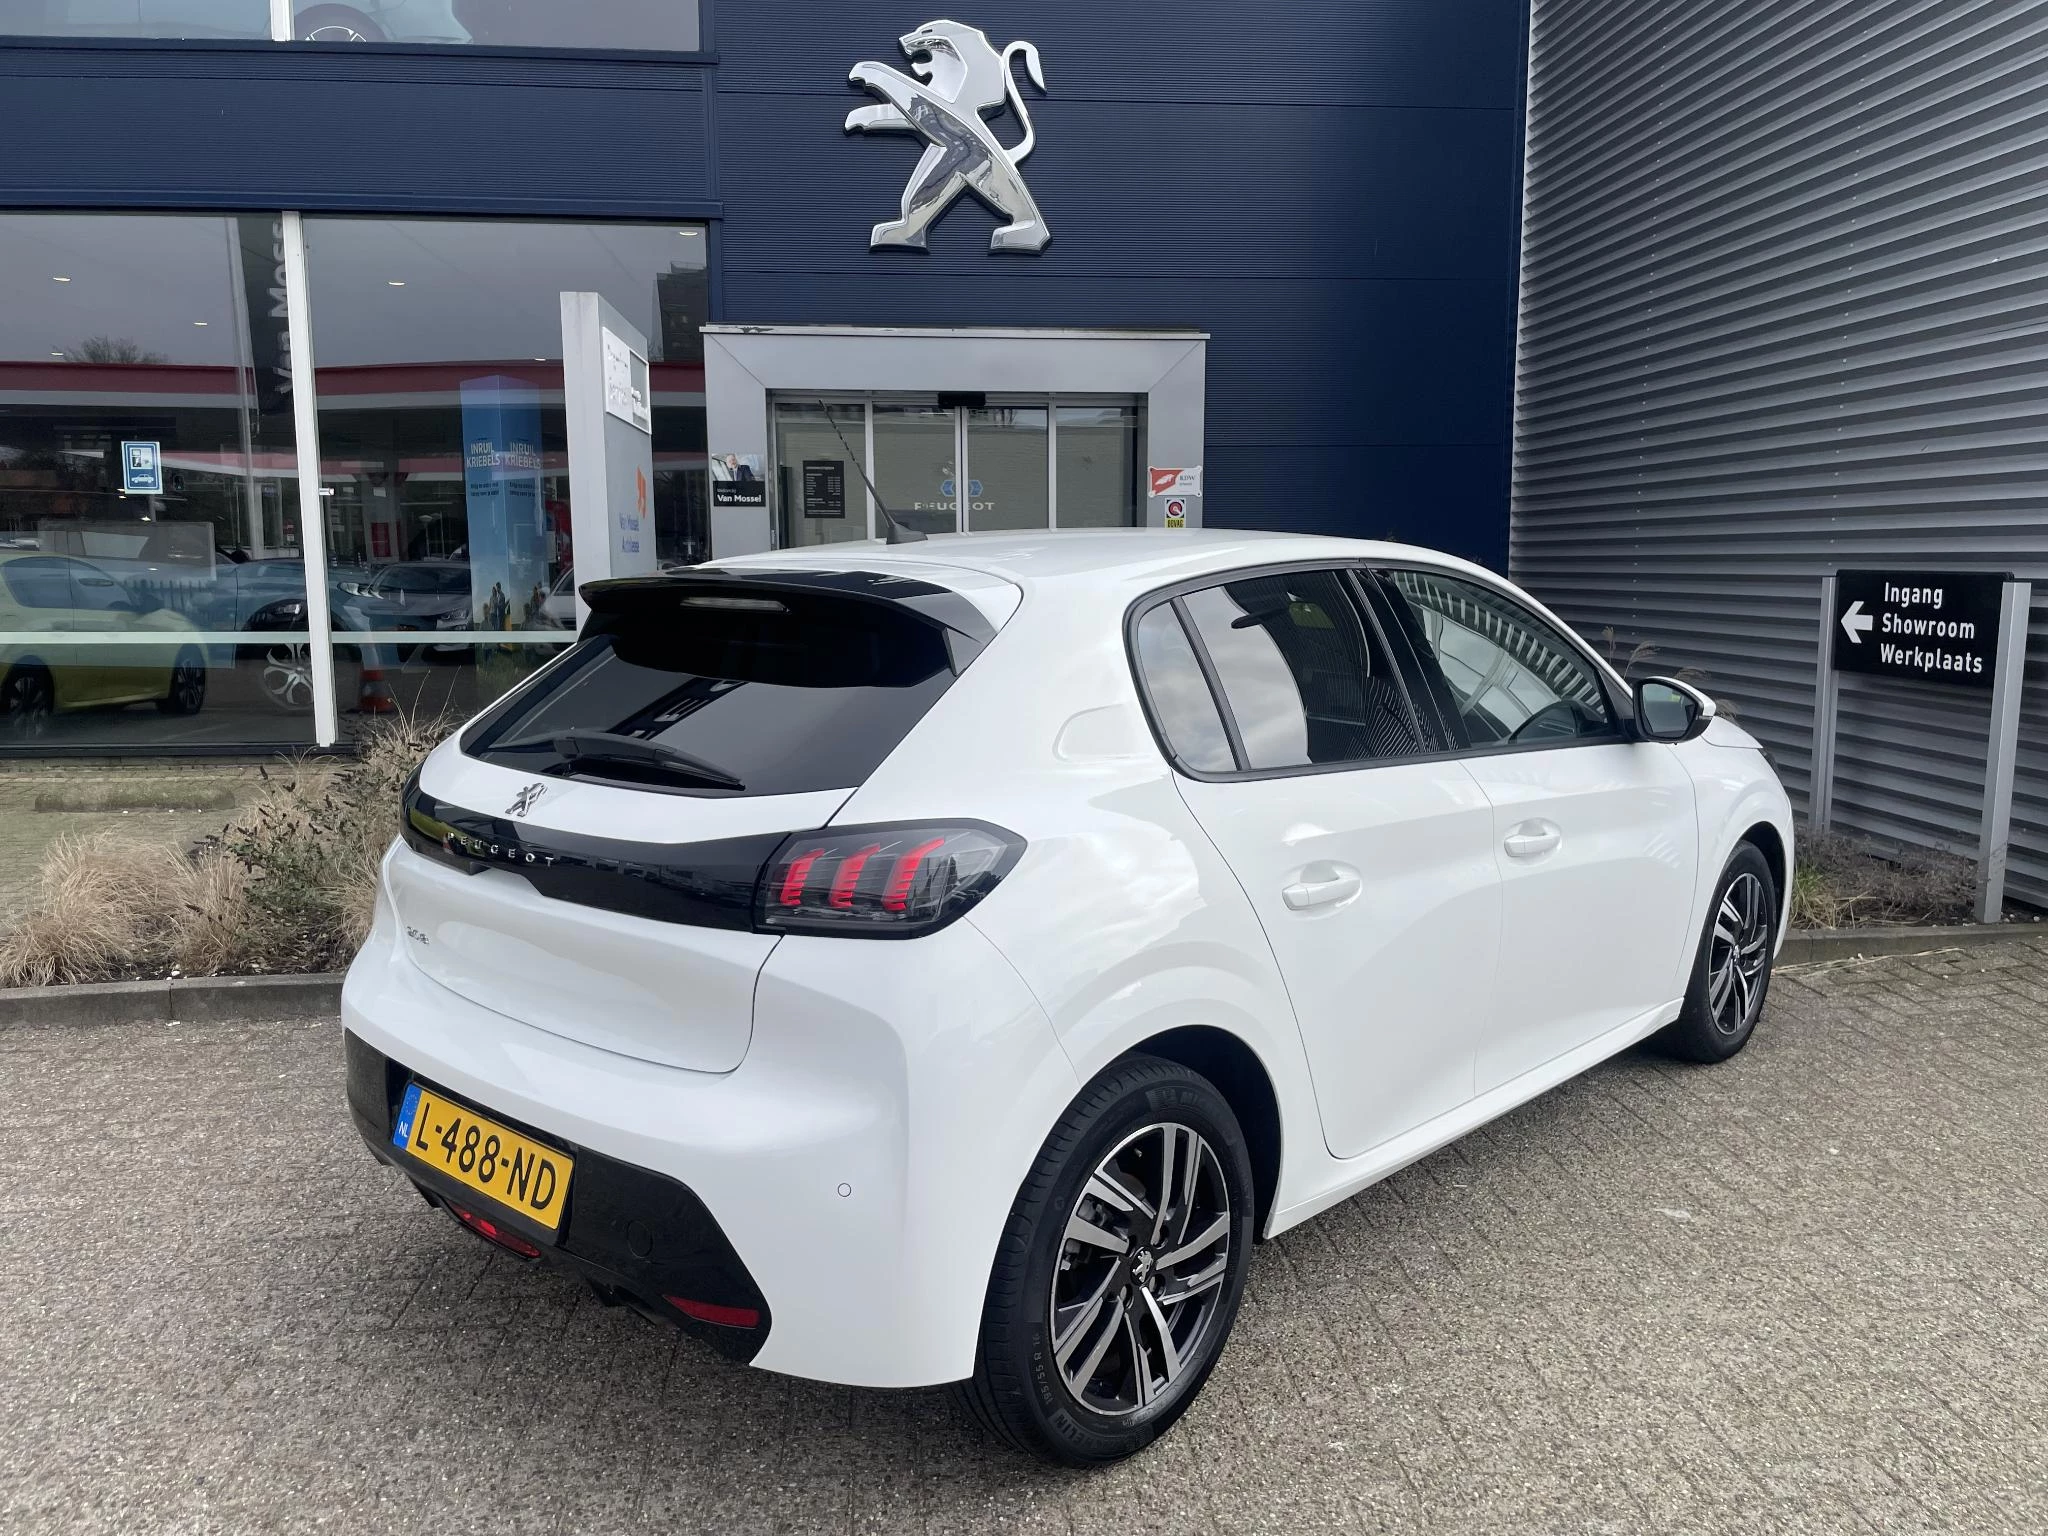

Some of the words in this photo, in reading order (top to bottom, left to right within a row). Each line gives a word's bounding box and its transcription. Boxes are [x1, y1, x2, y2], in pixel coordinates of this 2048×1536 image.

[470, 441, 495, 455] INRUIL
[510, 442, 536, 457] INRUIL
[466, 453, 501, 468] KRIEBELS
[504, 453, 541, 470] KRIEBELS
[717, 494, 733, 502] Van
[734, 494, 762, 503] Mossel
[1884, 582, 1943, 609] Ingang
[1882, 612, 1975, 639] Showroom
[1880, 642, 1983, 673] Werkplaats
[447, 832, 554, 868] PEUGEOT
[399, 1120, 409, 1138] NL
[415, 1102, 556, 1210] L-488-ND
